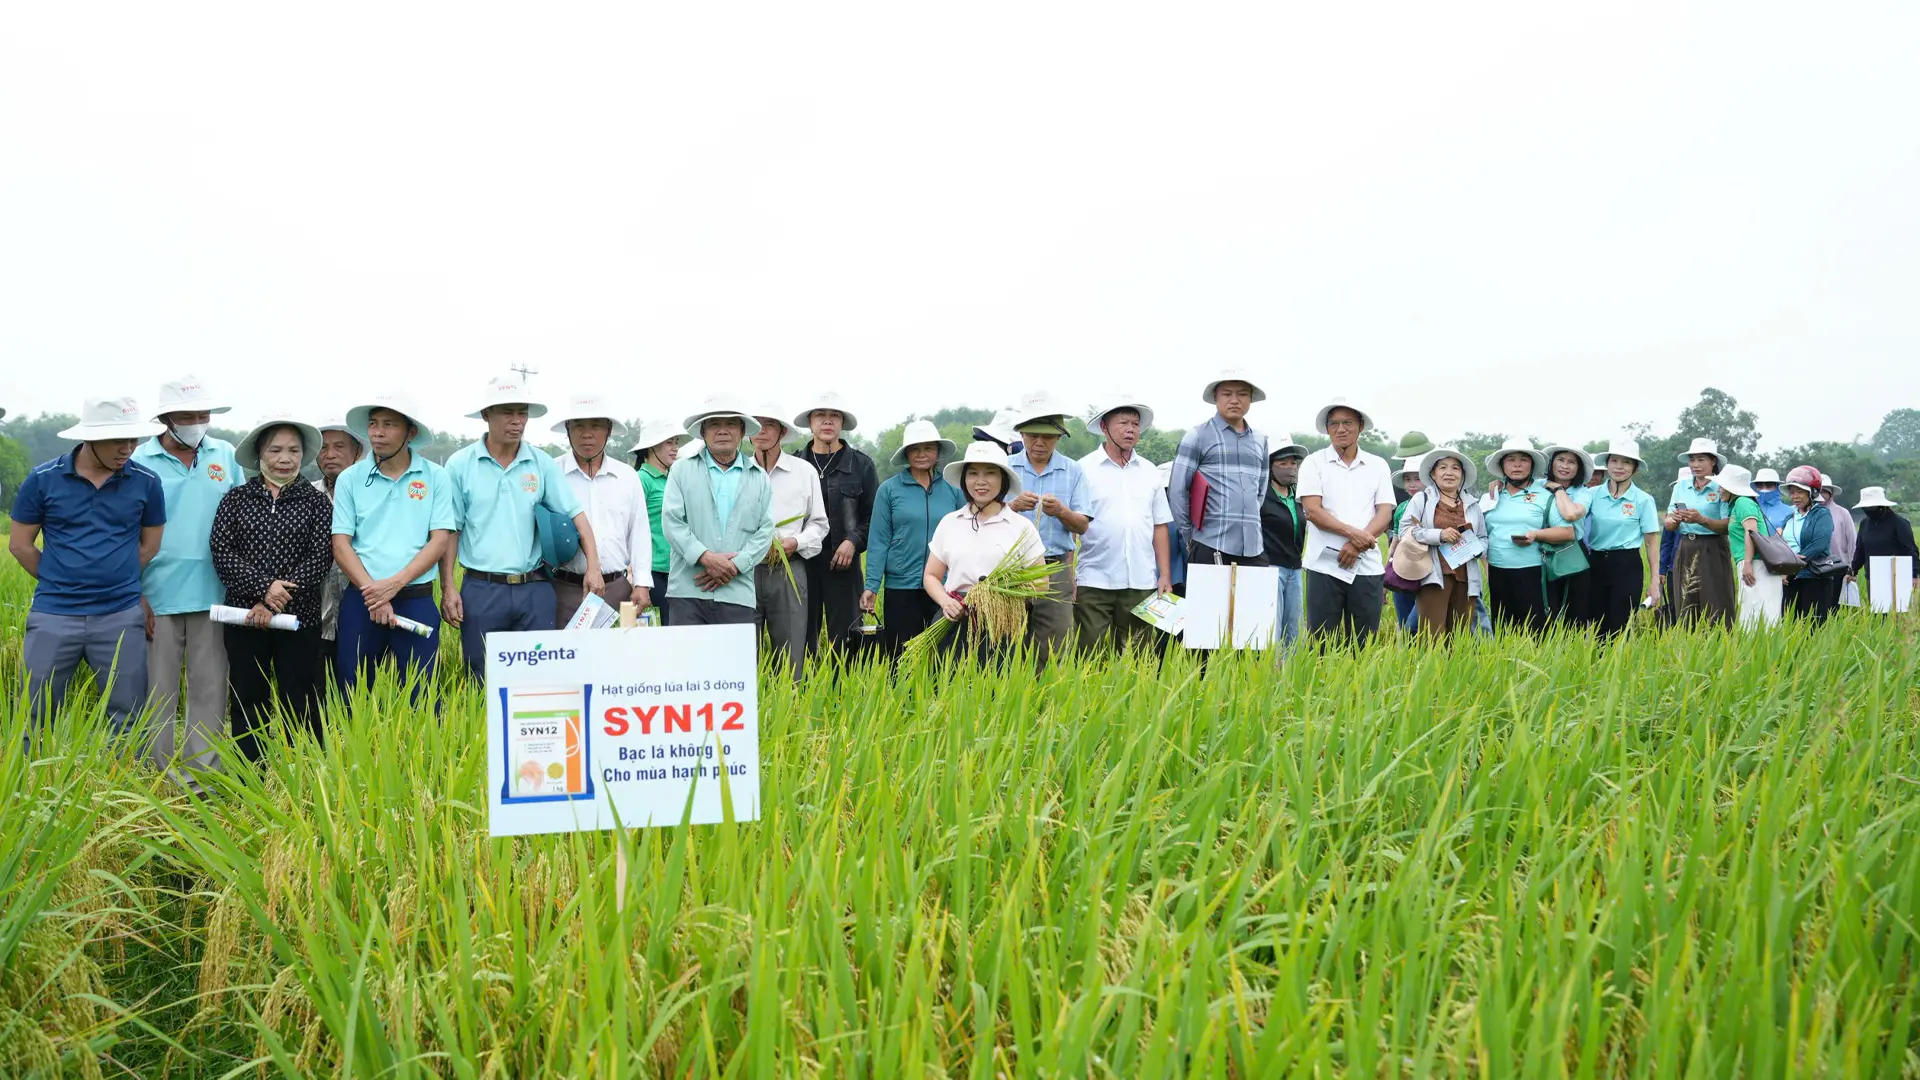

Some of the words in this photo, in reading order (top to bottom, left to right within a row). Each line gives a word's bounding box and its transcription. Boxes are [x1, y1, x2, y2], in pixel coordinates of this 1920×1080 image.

[498, 647, 575, 667] syngenta
[601, 684, 623, 698] Hạt
[626, 681, 661, 696] giống
[664, 681, 683, 692] lúa
[686, 681, 700, 691] lai
[703, 680, 711, 691] 3
[713, 679, 745, 692] dòng
[603, 702, 745, 736] SYN12
[520, 726, 558, 736] SYN12
[619, 746, 646, 763] Bạc
[652, 744, 664, 759] lá
[670, 743, 713, 759] không
[603, 767, 631, 782] Cho
[636, 765, 667, 780] mùa
